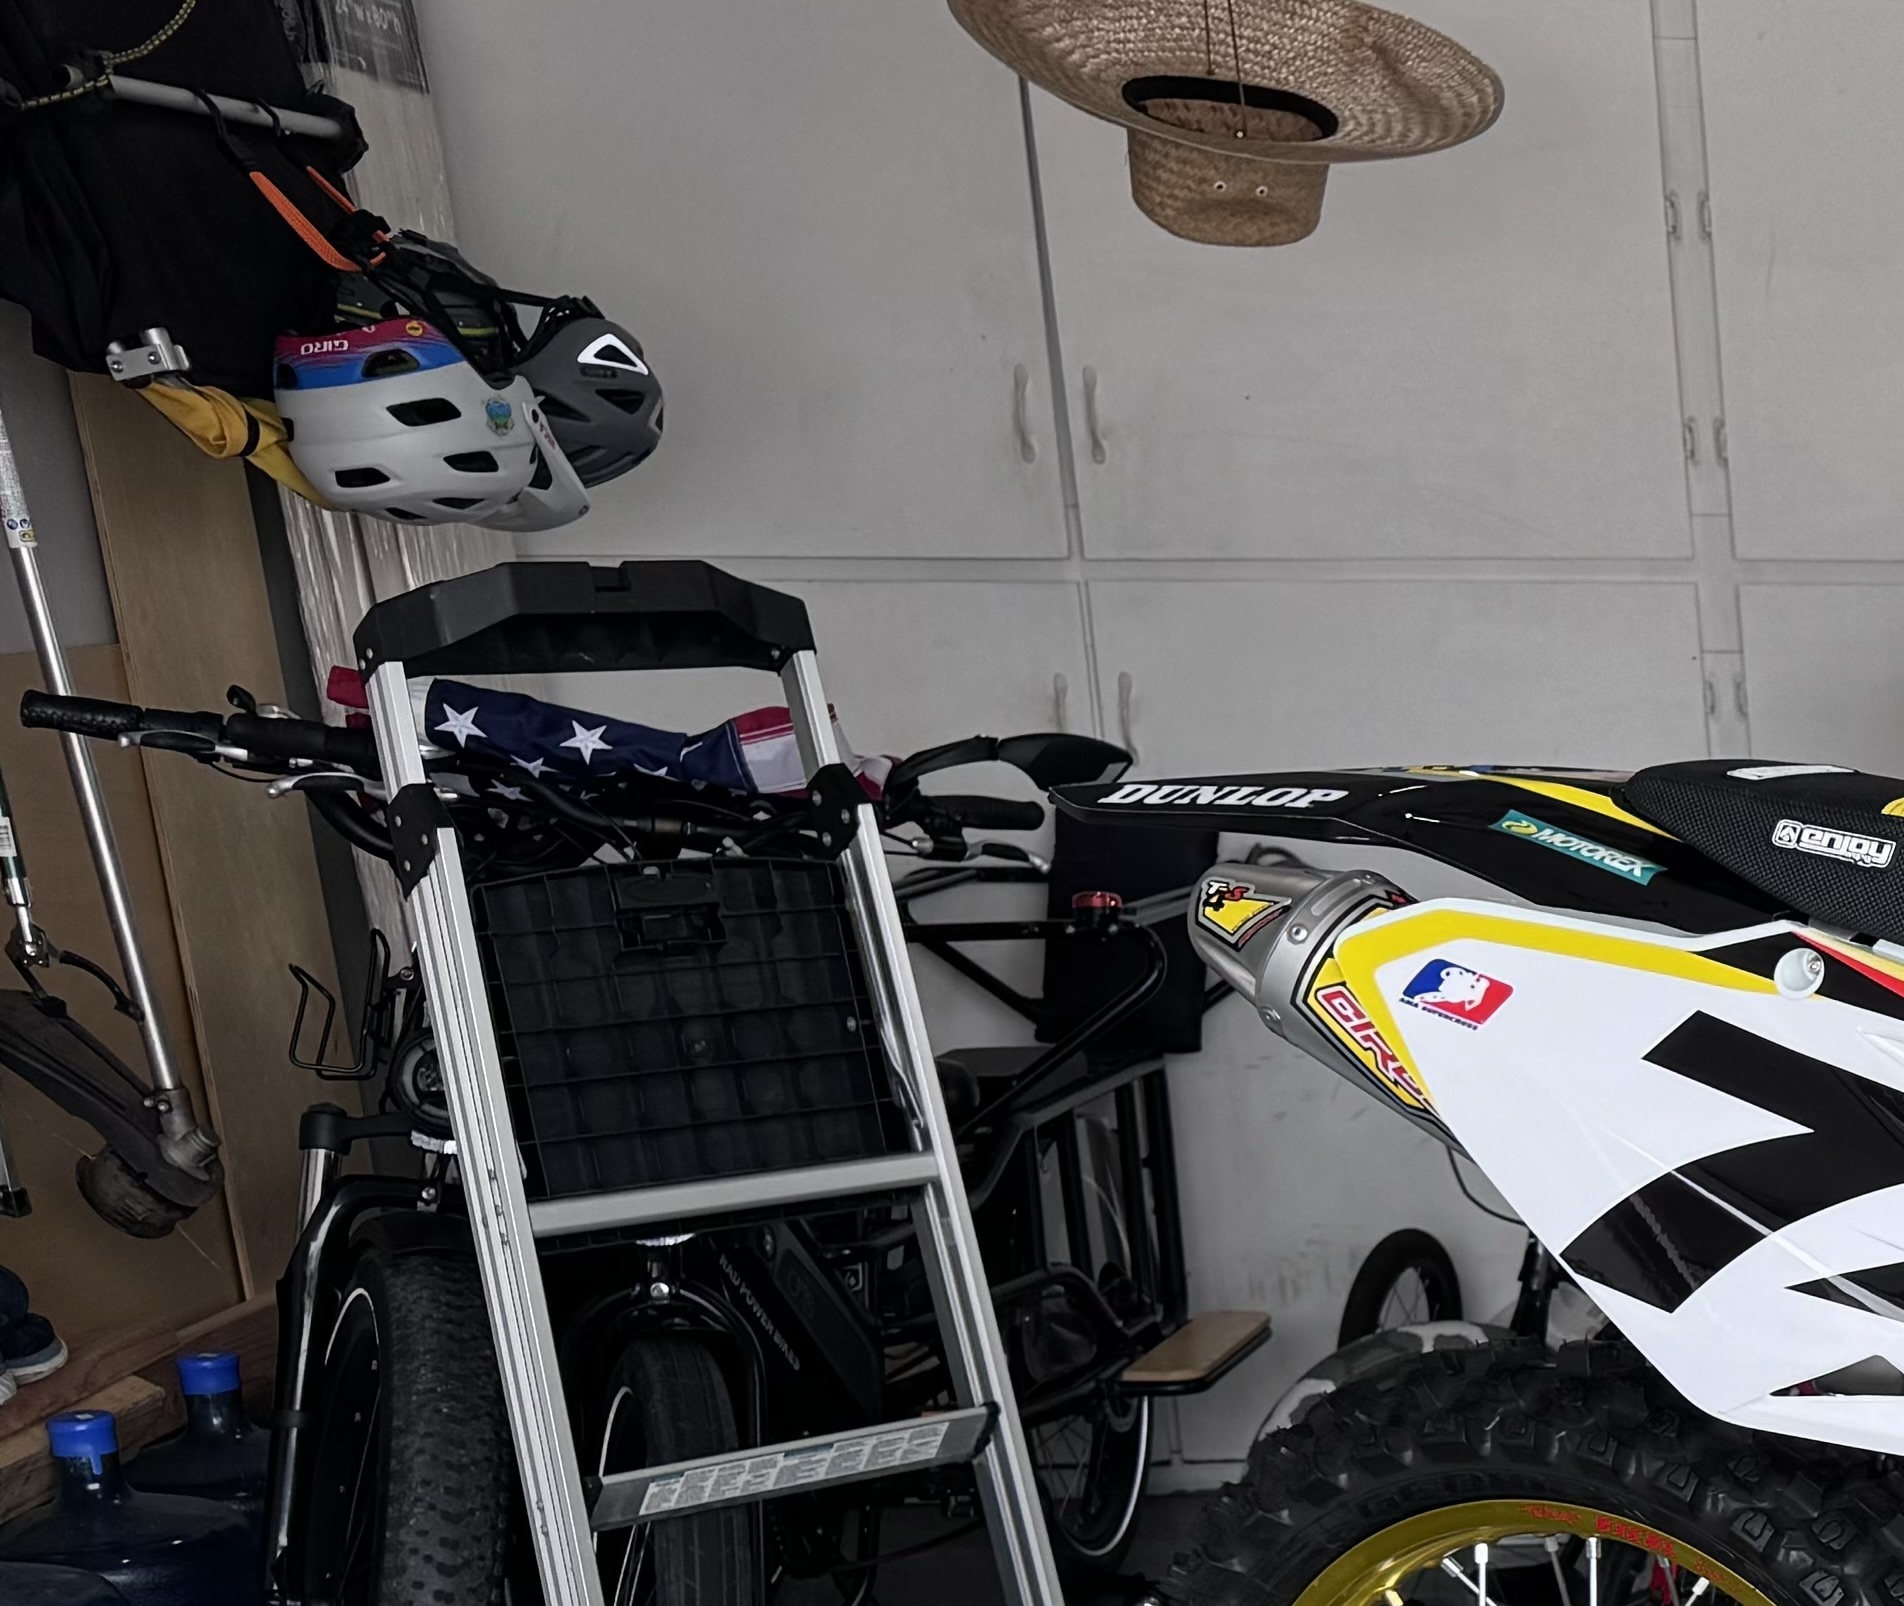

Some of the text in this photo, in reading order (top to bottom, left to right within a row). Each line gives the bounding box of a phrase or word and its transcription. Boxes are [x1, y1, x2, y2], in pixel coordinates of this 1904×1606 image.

[300, 338, 349, 355] GIRO
[1098, 783, 1349, 808] DUNLOP
[1537, 828, 1652, 877] MOTOREX
[1800, 827, 1892, 866] enjoy
